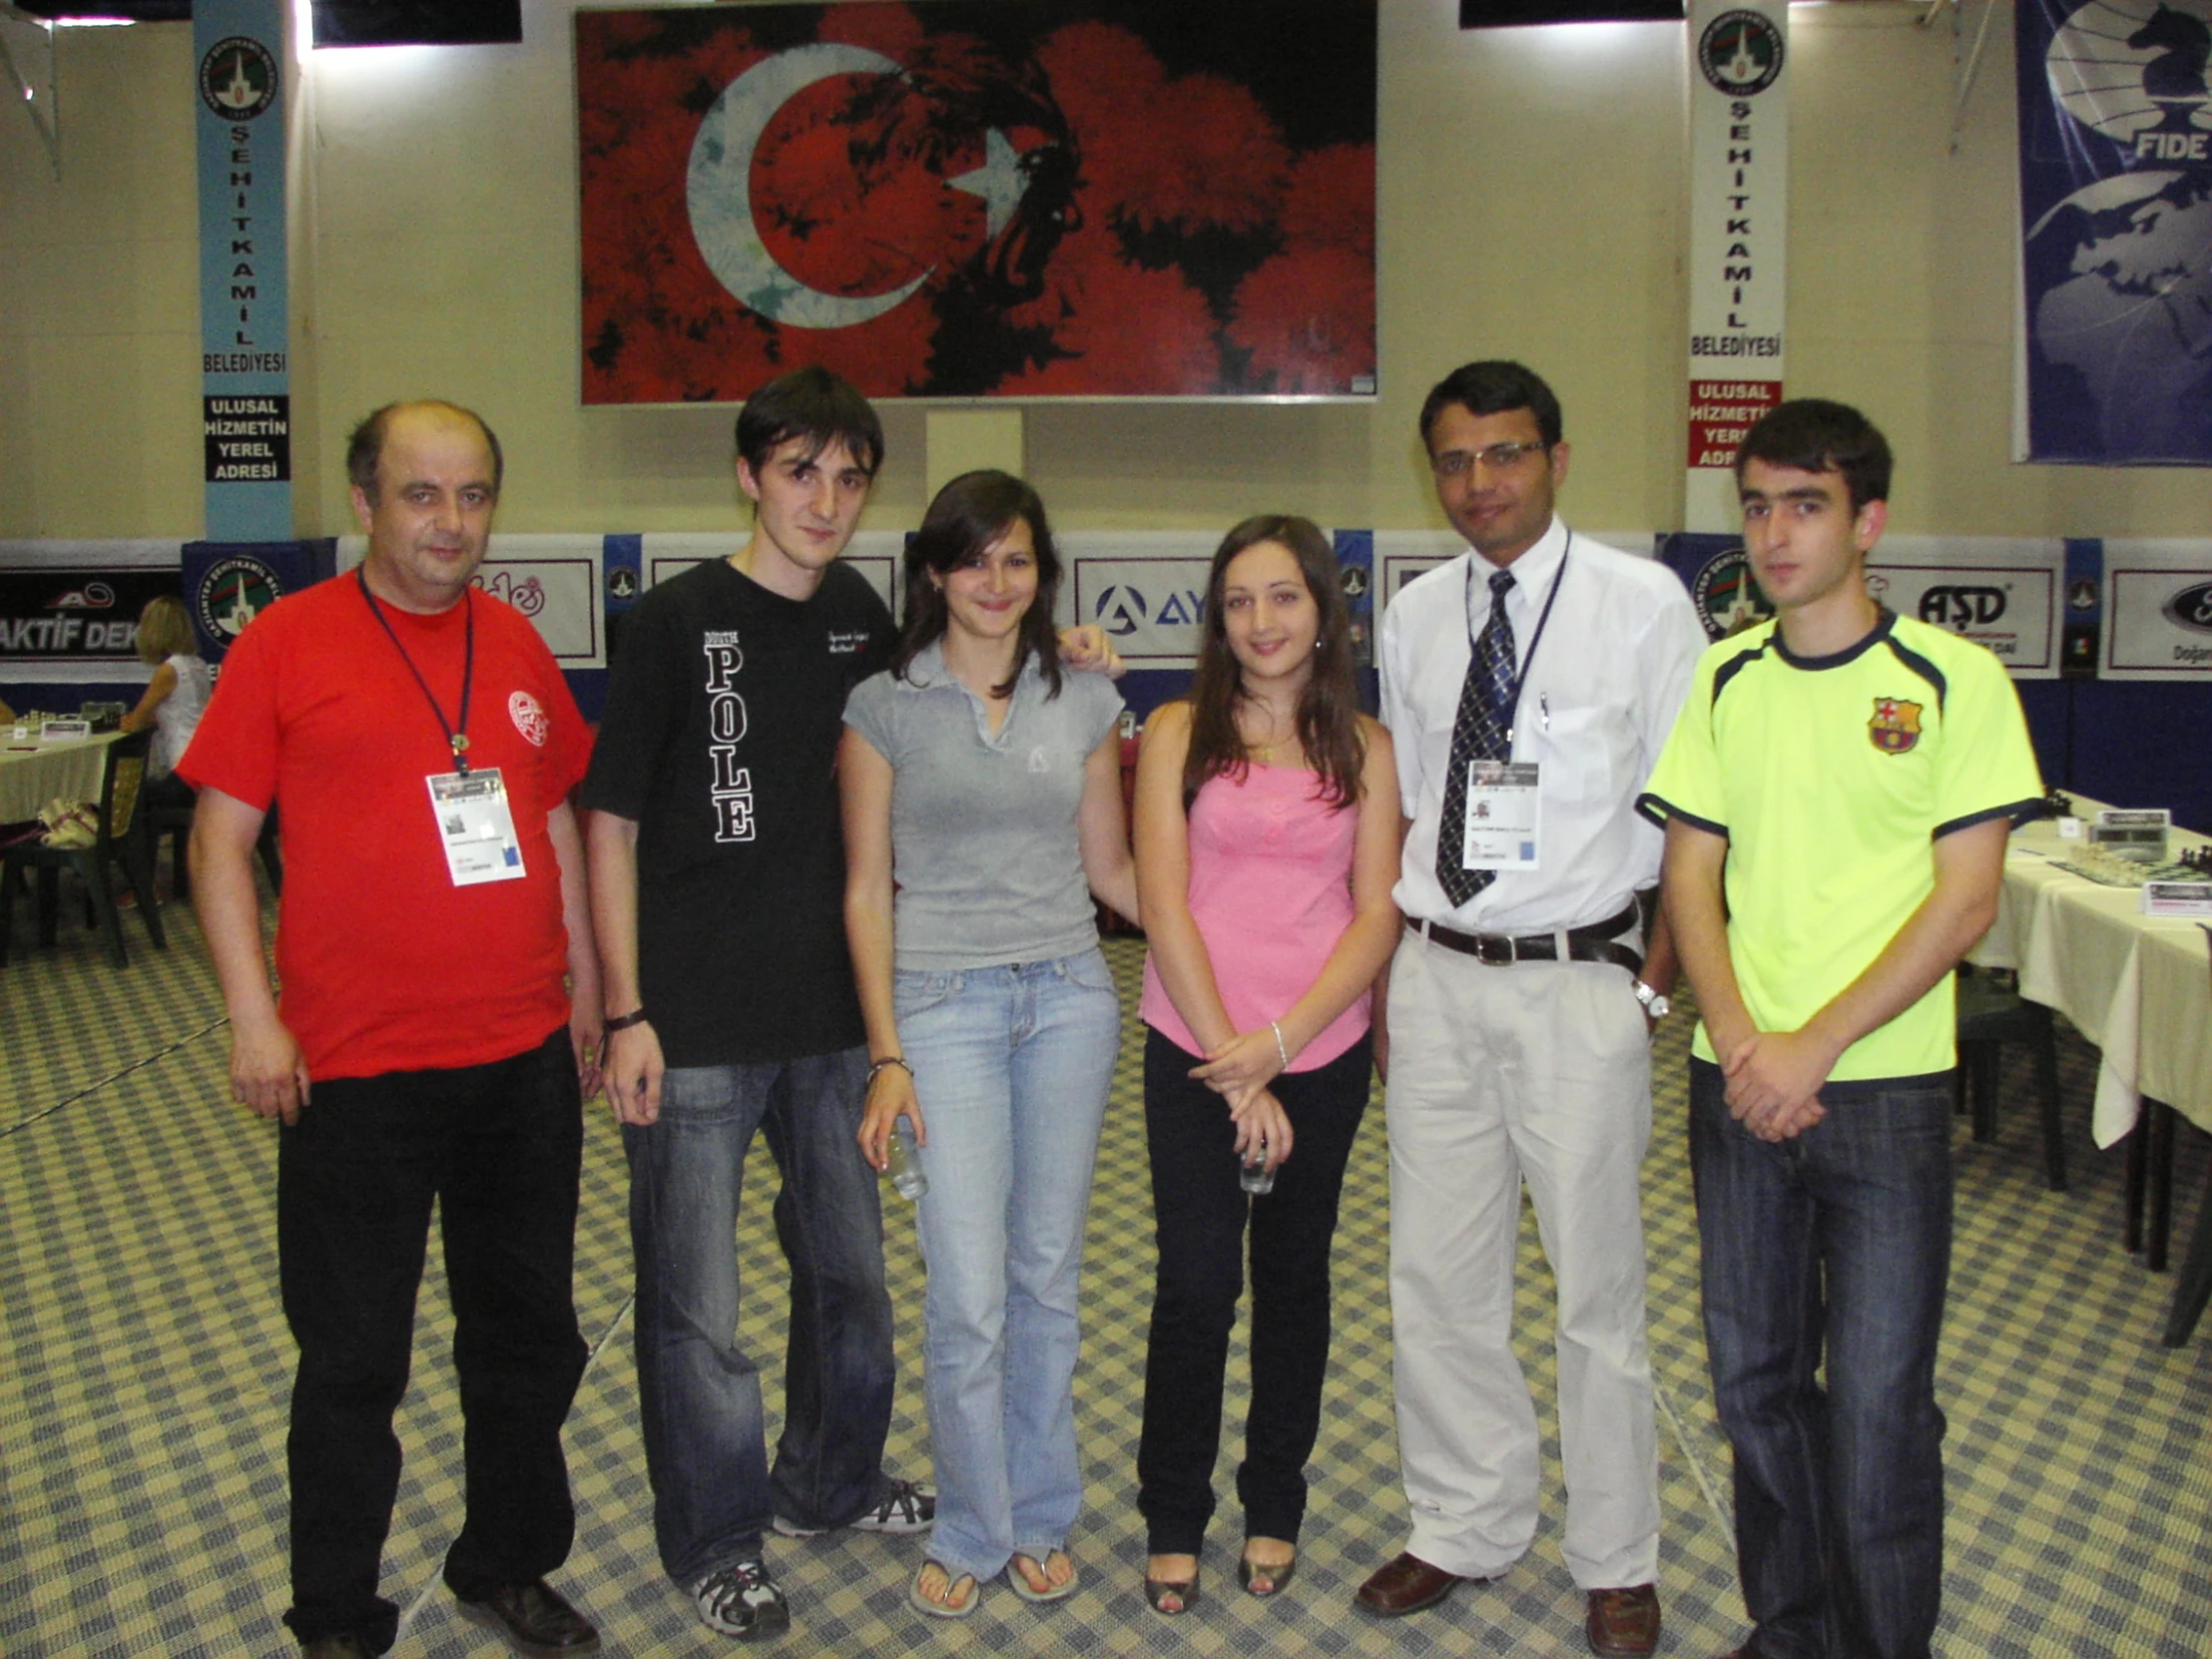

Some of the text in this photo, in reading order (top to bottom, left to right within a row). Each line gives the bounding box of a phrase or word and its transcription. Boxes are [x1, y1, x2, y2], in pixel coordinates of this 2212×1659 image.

[2136, 133, 2209, 160] FIDE
[1691, 332, 1781, 357] BELEDİYESİ
[204, 350, 286, 373] BELEDİYESİ
[1698, 384, 1771, 399] ULUSAL
[211, 399, 278, 414] ULUSAL
[1689, 403, 1771, 422] HİZMETİ
[205, 418, 287, 435] HİZMETİN
[219, 442, 274, 457] YEREL
[215, 460, 277, 479] ADRESİ
[1919, 585, 2006, 631] AŞD
[0, 612, 83, 650] AKTİF
[704, 644, 756, 842] POLE
